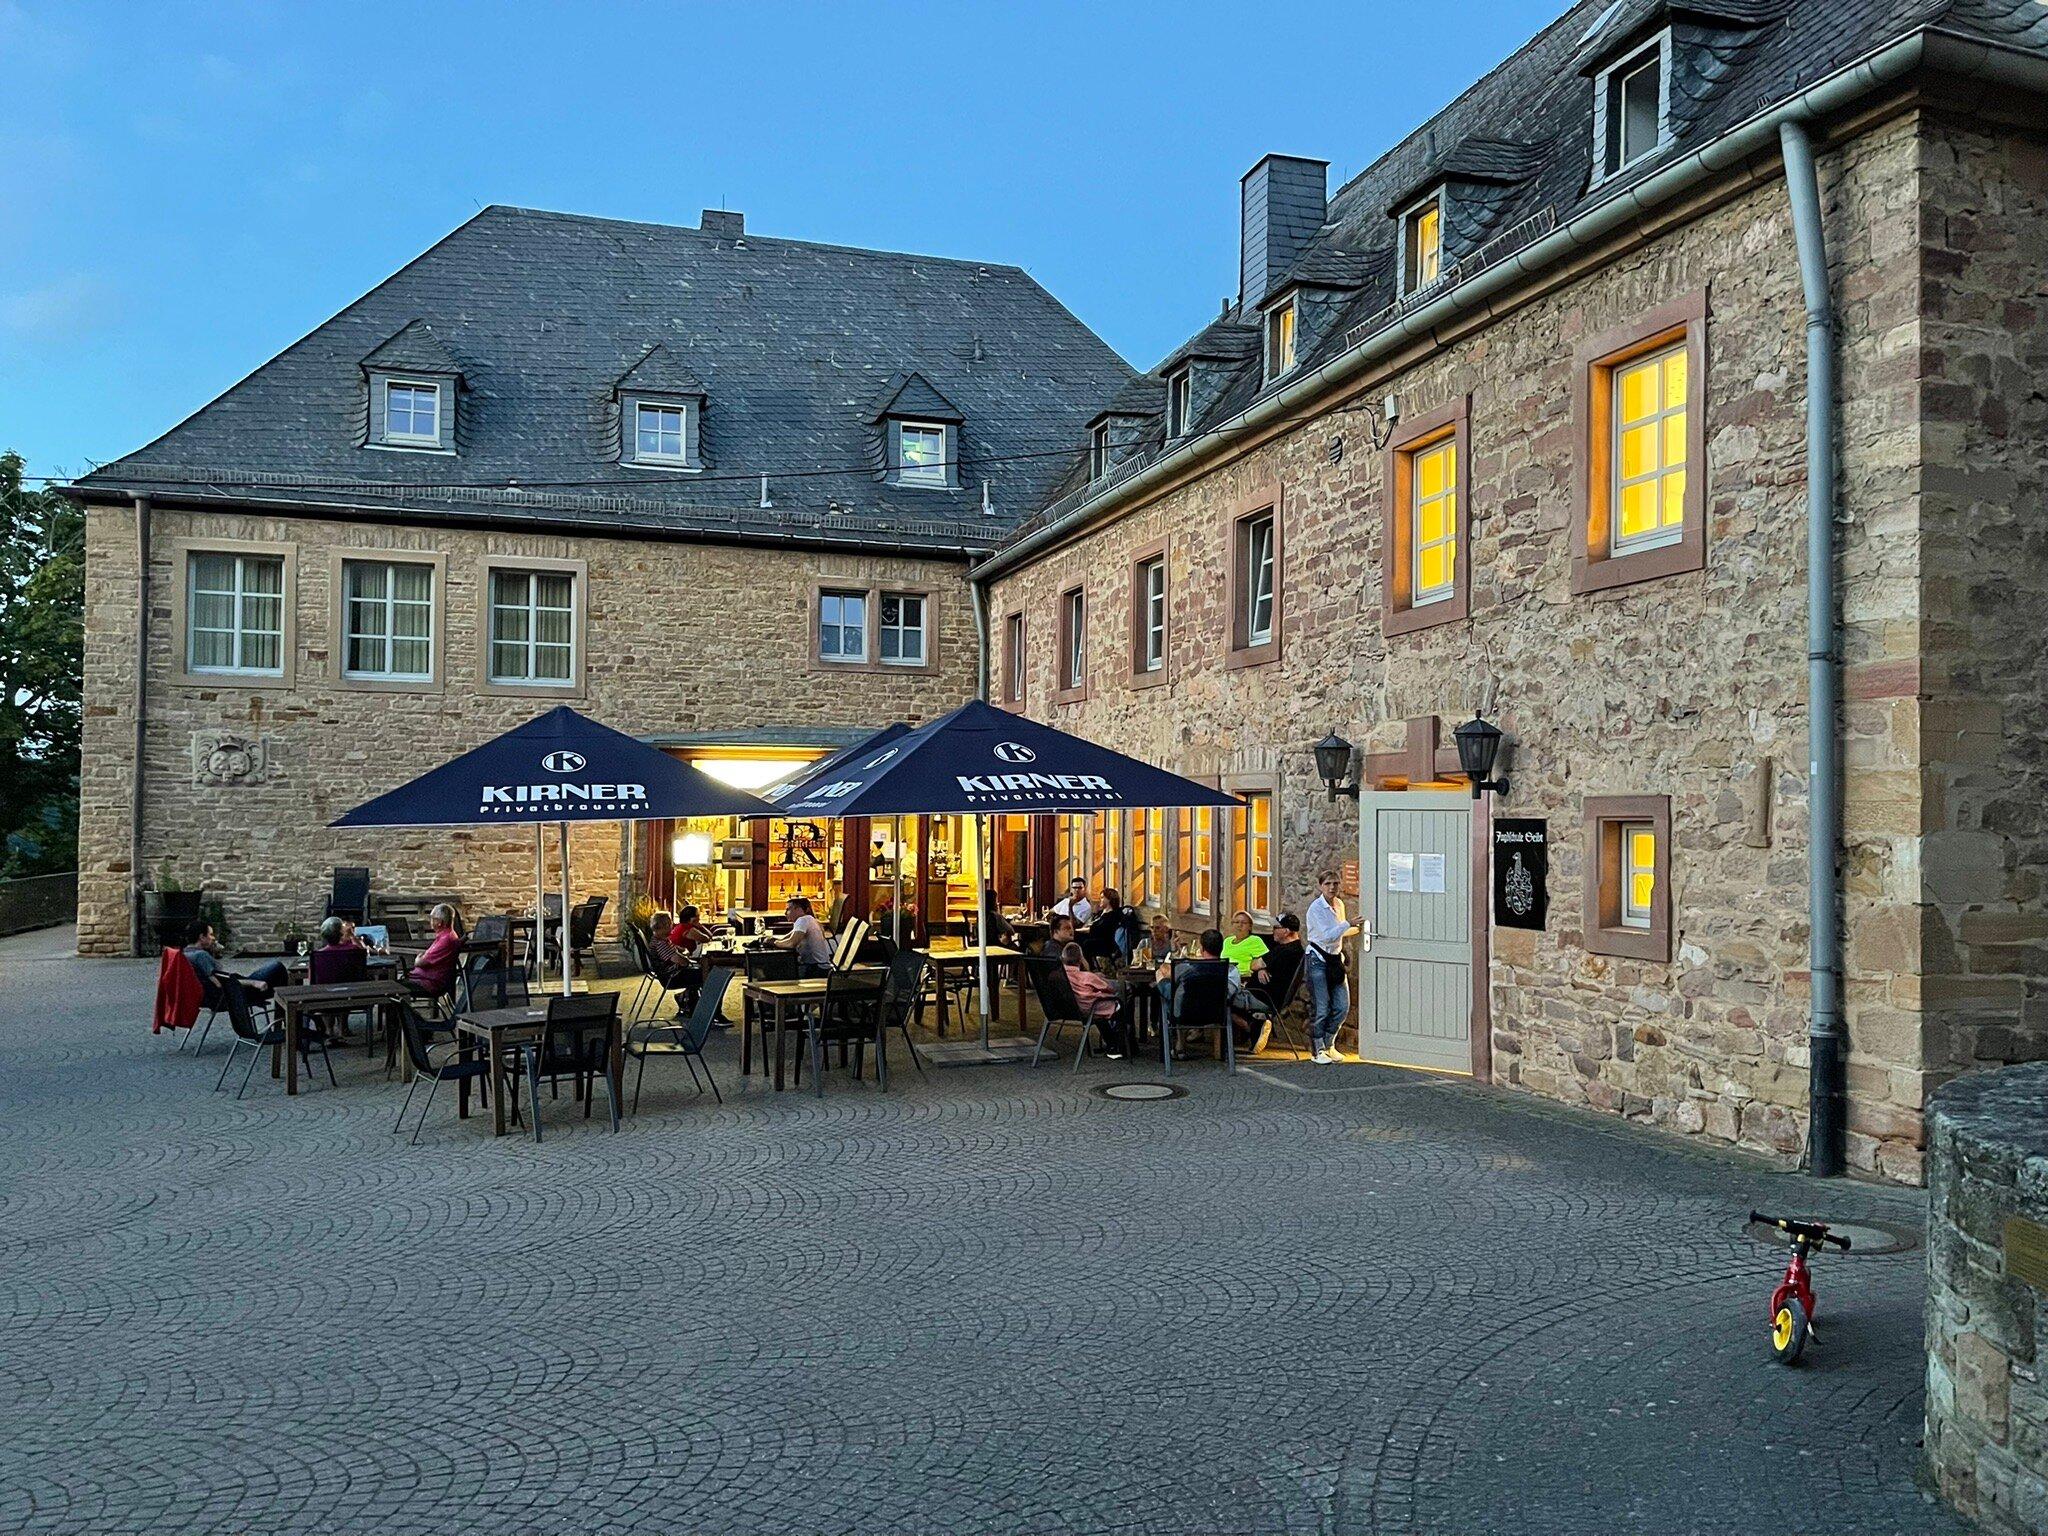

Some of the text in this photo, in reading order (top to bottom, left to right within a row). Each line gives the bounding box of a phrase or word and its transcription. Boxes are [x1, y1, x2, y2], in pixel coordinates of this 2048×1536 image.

[551, 752, 584, 771] K
[1001, 742, 1034, 762] K
[956, 773, 1113, 792] KIRNER
[482, 783, 647, 803] KIRNER
[967, 792, 1123, 803] Privatbrauerei
[479, 802, 650, 814] Privatbrauerei
